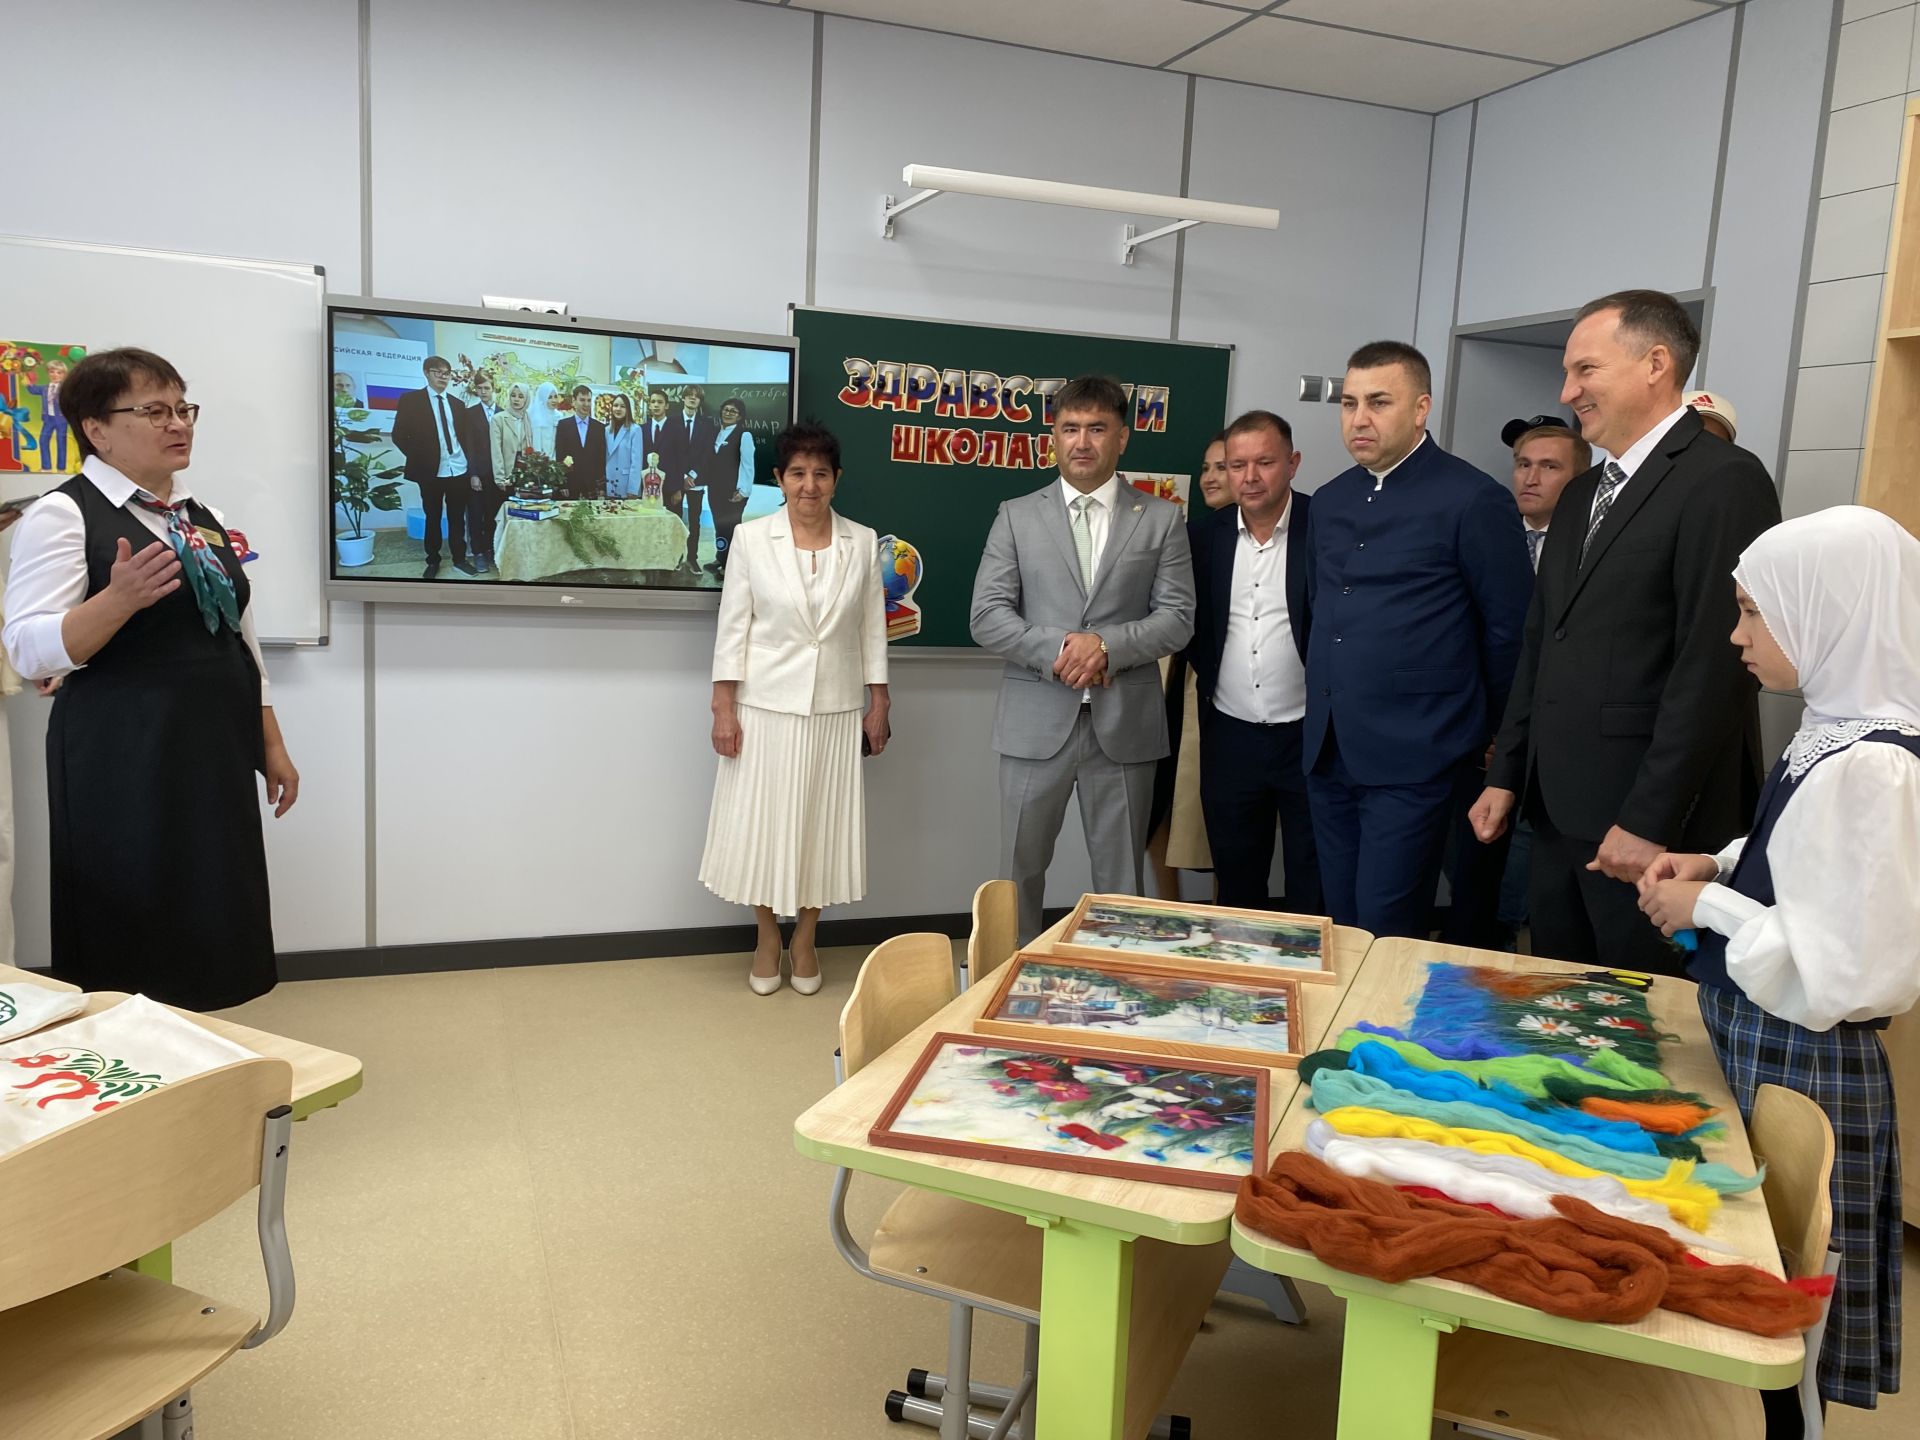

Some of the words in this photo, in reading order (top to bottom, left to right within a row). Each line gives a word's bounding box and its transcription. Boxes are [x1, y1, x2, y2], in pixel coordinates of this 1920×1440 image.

[376, 351, 421, 361] ФЕДЕРАЦИЯ
[838, 357, 1170, 432] ЗДРАВСТЙ
[891, 424, 1056, 469] ШКОЛА!
